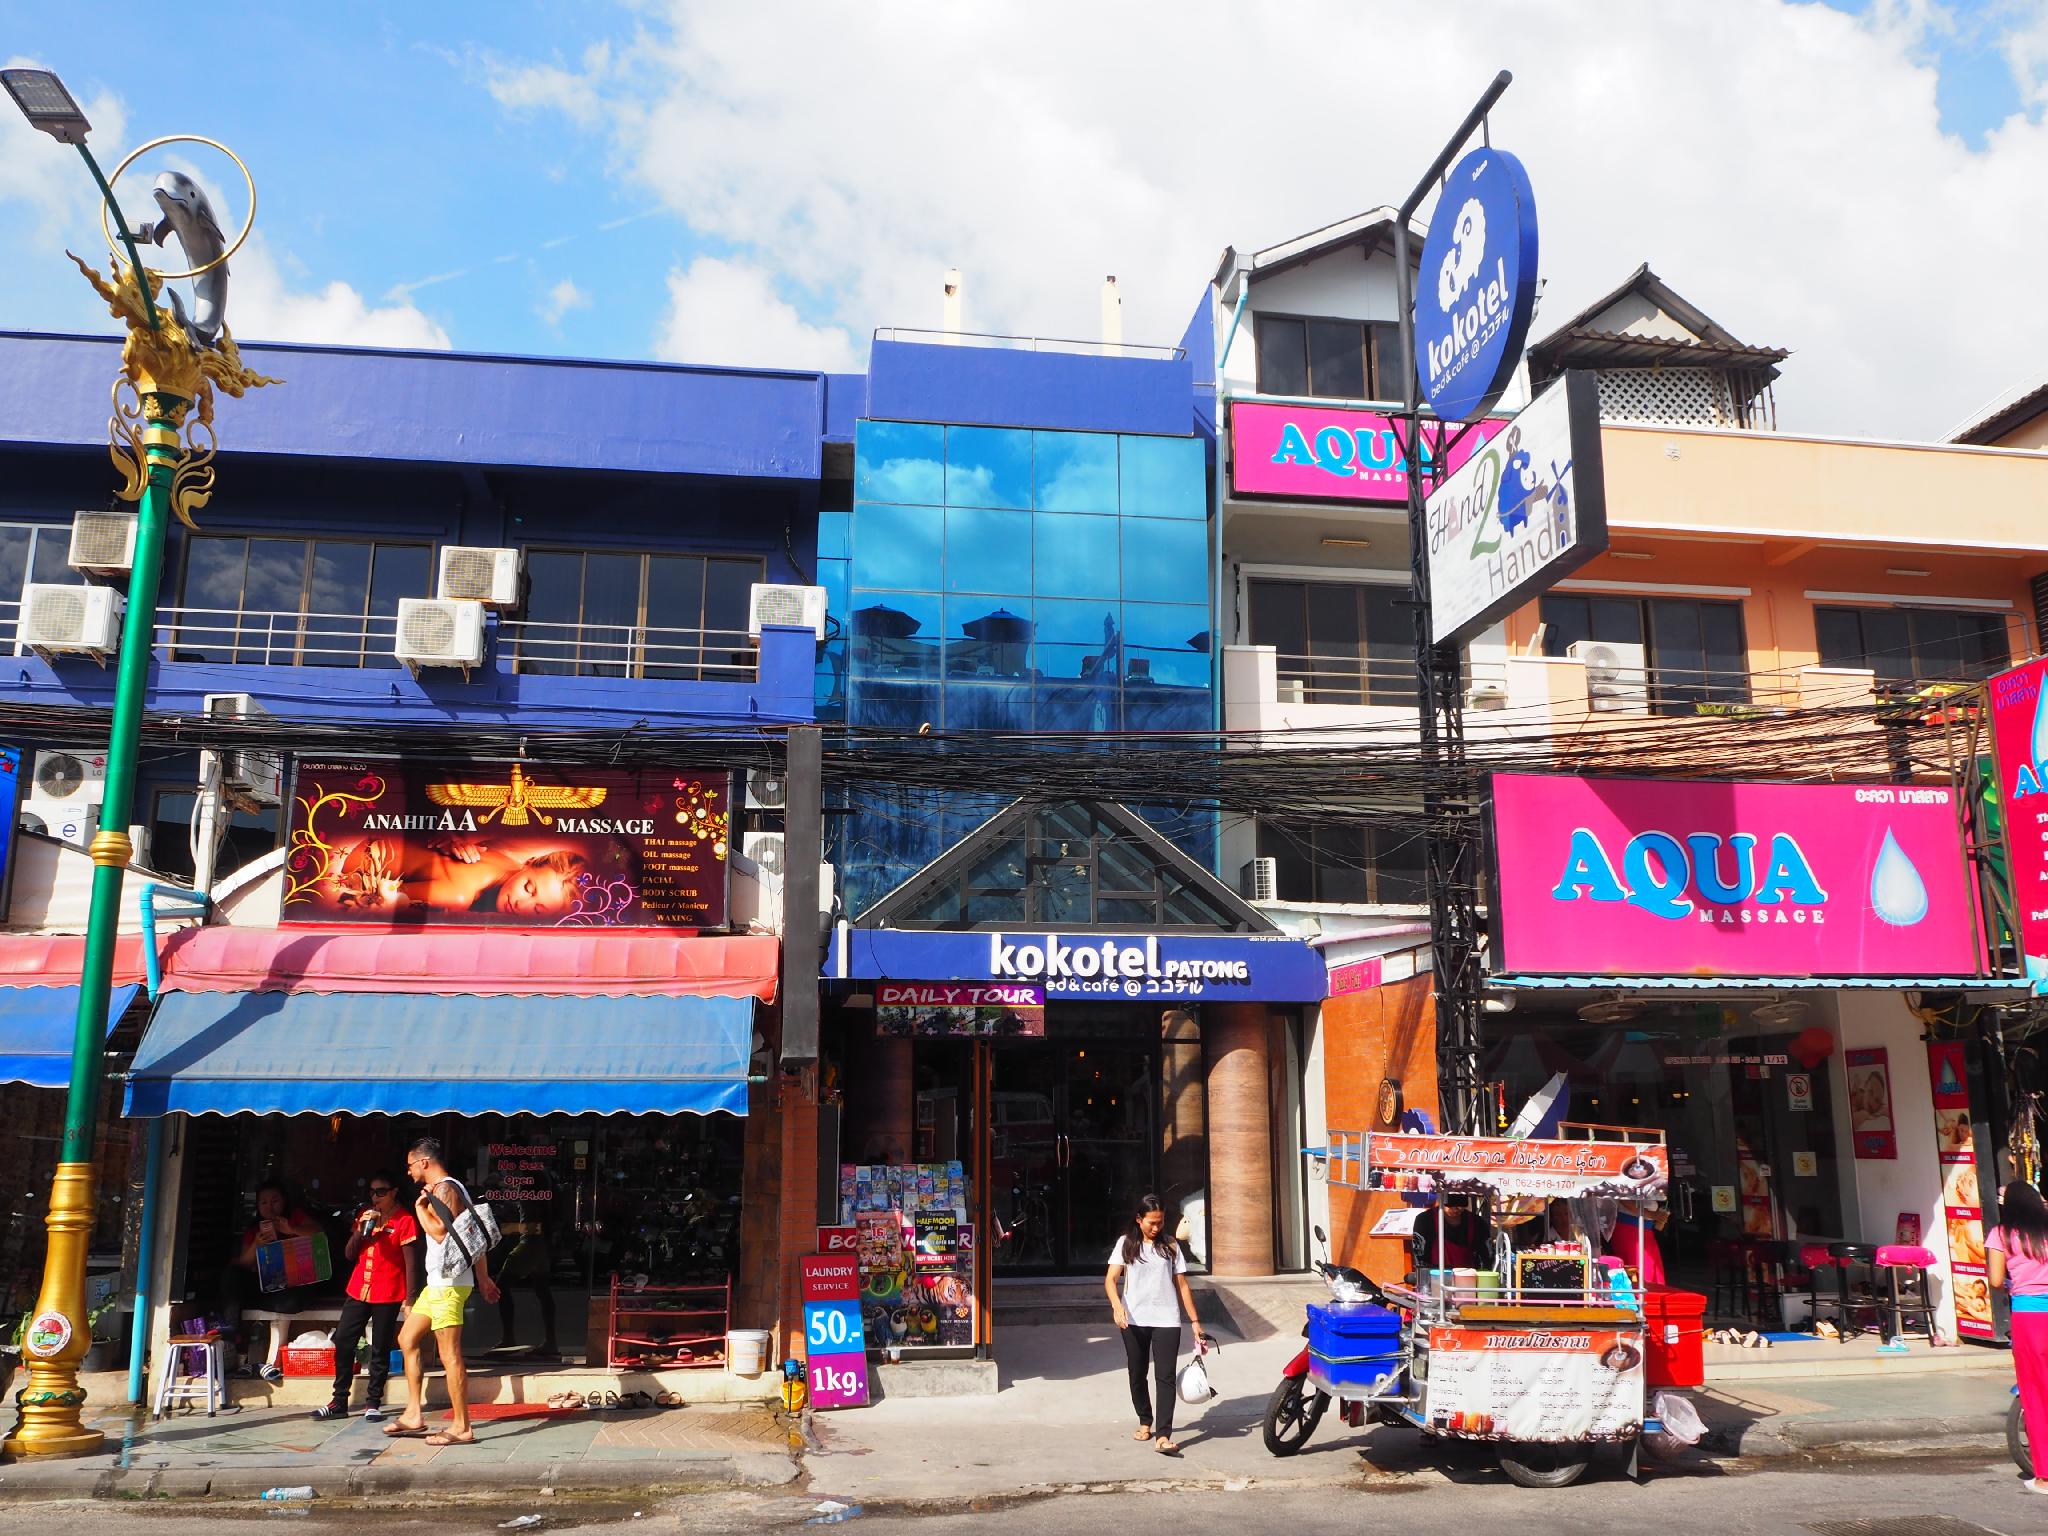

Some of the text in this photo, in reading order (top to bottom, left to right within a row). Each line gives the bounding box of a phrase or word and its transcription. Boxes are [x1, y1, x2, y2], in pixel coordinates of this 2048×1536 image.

[1428, 257, 1508, 382] kokotel
[1471, 339, 1480, 359] @
[1481, 305, 1509, 346] ココテル
[1470, 448, 1501, 560] 2
[1488, 512, 1553, 597] Hand
[363, 809, 654, 835] ANAHITAA MASSAGE
[644, 838, 697, 848] THAI massage
[643, 850, 691, 860] OIL massage
[643, 863, 699, 873] FOOT massage
[1552, 827, 1828, 919] AQUA
[642, 876, 673, 884] FACIAL
[642, 888, 698, 897] BODY SCRUB
[656, 914, 693, 922] WAXING
[1699, 909, 1825, 924] MASSAGE
[990, 933, 1248, 979] kokotel PATONG
[1124, 979, 1141, 997] @
[1146, 979, 1203, 995] ココテル
[882, 987, 1037, 1005] DAILY TOUR
[488, 1143, 557, 1156] Welcome
[1408, 1141, 1506, 1165] กาแฟโบราณ
[498, 1159, 545, 1171] No Sex
[504, 1175, 535, 1188] Open
[485, 1189, 553, 1200] 08.00-24.00
[933, 1216, 956, 1225] MOON
[805, 1266, 854, 1278] LAUNDRY
[812, 1282, 849, 1291] SERVICE
[809, 1310, 861, 1345] 50.-
[1487, 1332, 1590, 1349] กาแฟโบราณ
[812, 1366, 864, 1397] 1kg.
